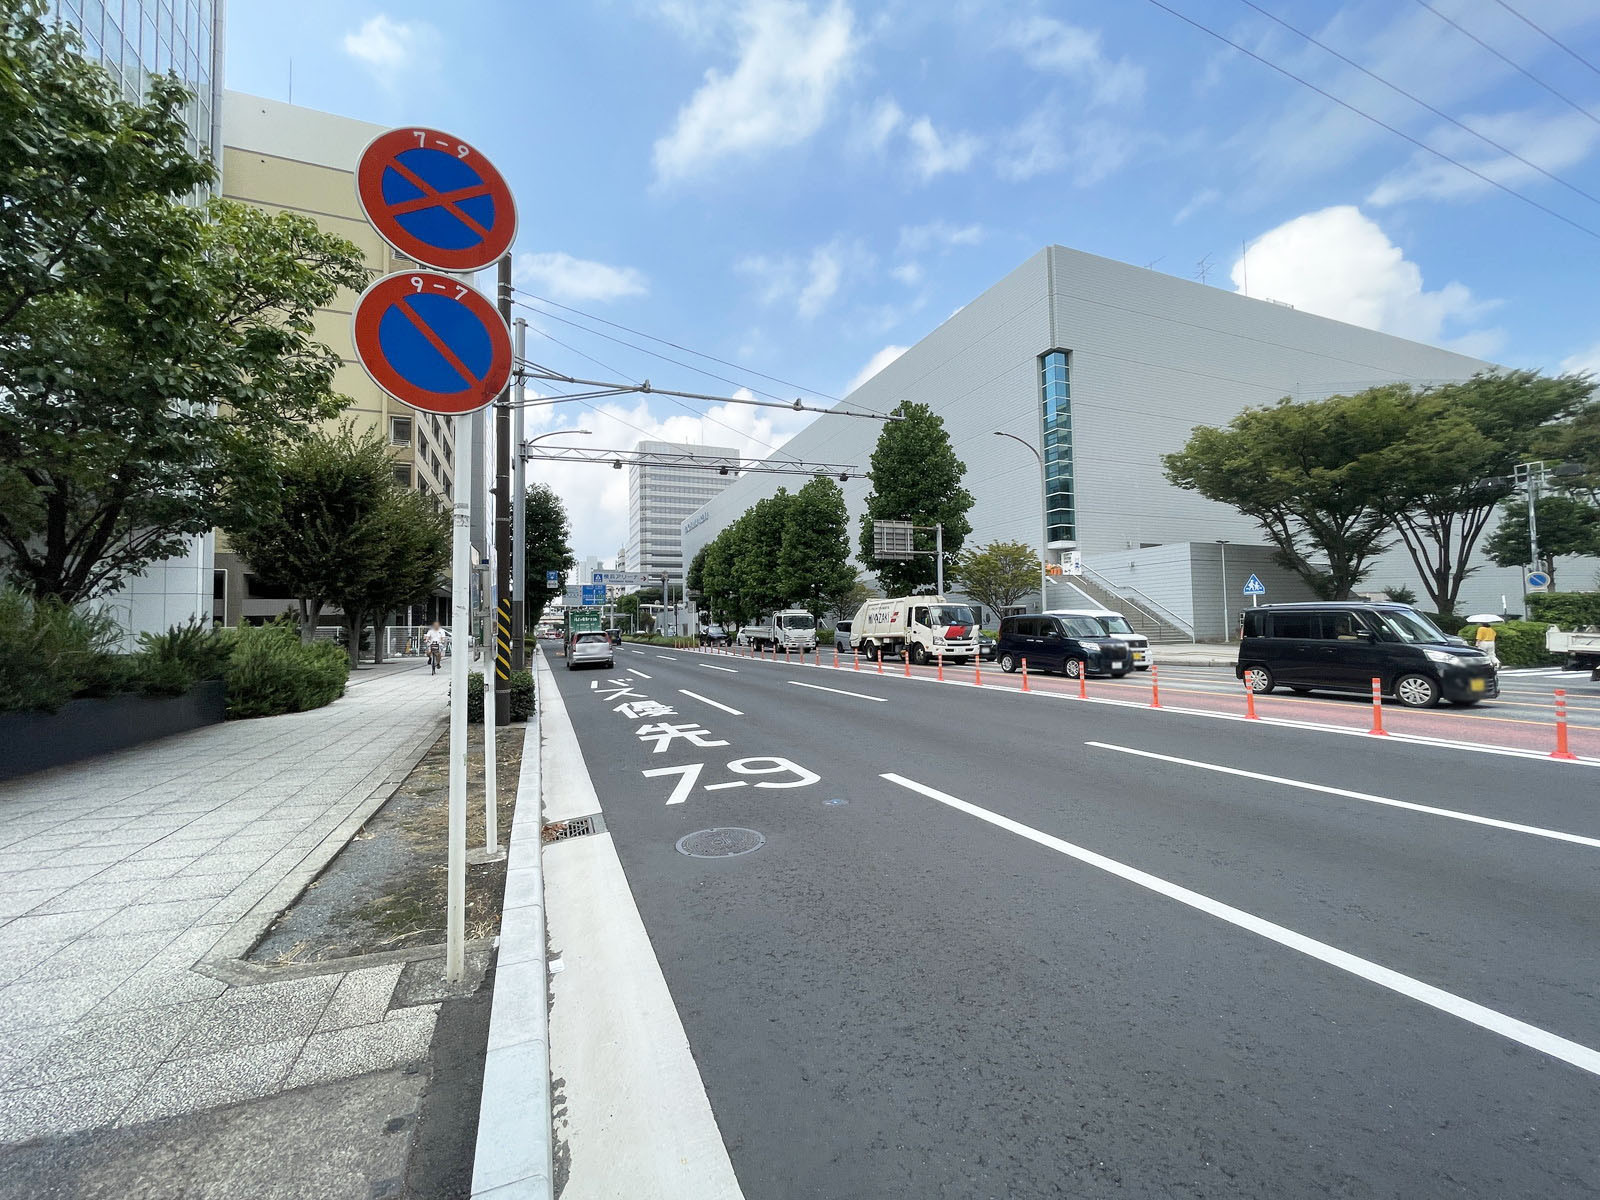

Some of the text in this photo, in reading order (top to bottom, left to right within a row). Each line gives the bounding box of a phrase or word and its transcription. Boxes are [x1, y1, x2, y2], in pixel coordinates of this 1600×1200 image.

[413, 131, 470, 159] 7-9
[410, 276, 469, 301] 9-7
[641, 756, 821, 806] 7-9
